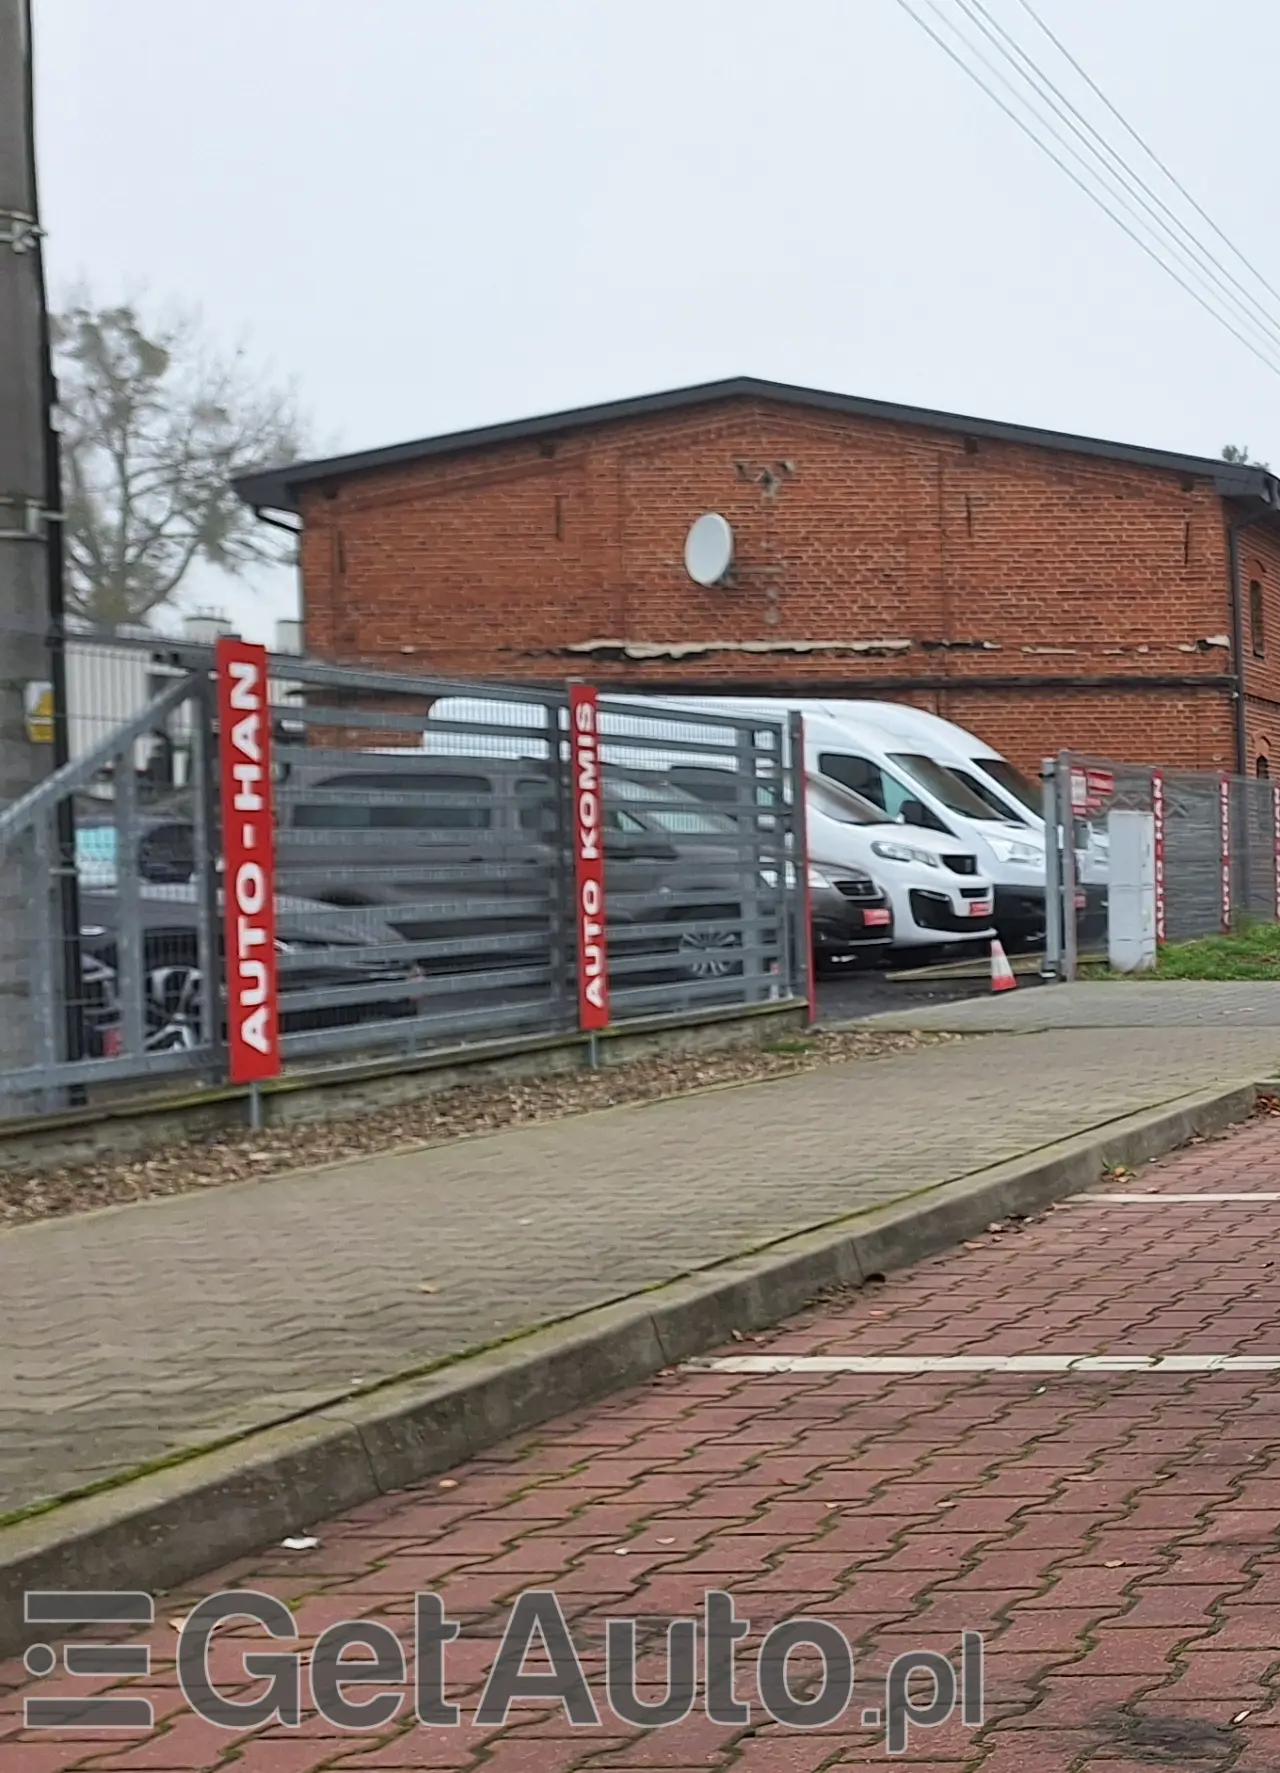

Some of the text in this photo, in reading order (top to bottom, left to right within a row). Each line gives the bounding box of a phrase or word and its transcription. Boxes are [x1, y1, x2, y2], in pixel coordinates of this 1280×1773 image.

[229, 661, 263, 811] HAN
[576, 702, 605, 1009] AUTO KOMIS
[235, 861, 271, 1055] AUTO
